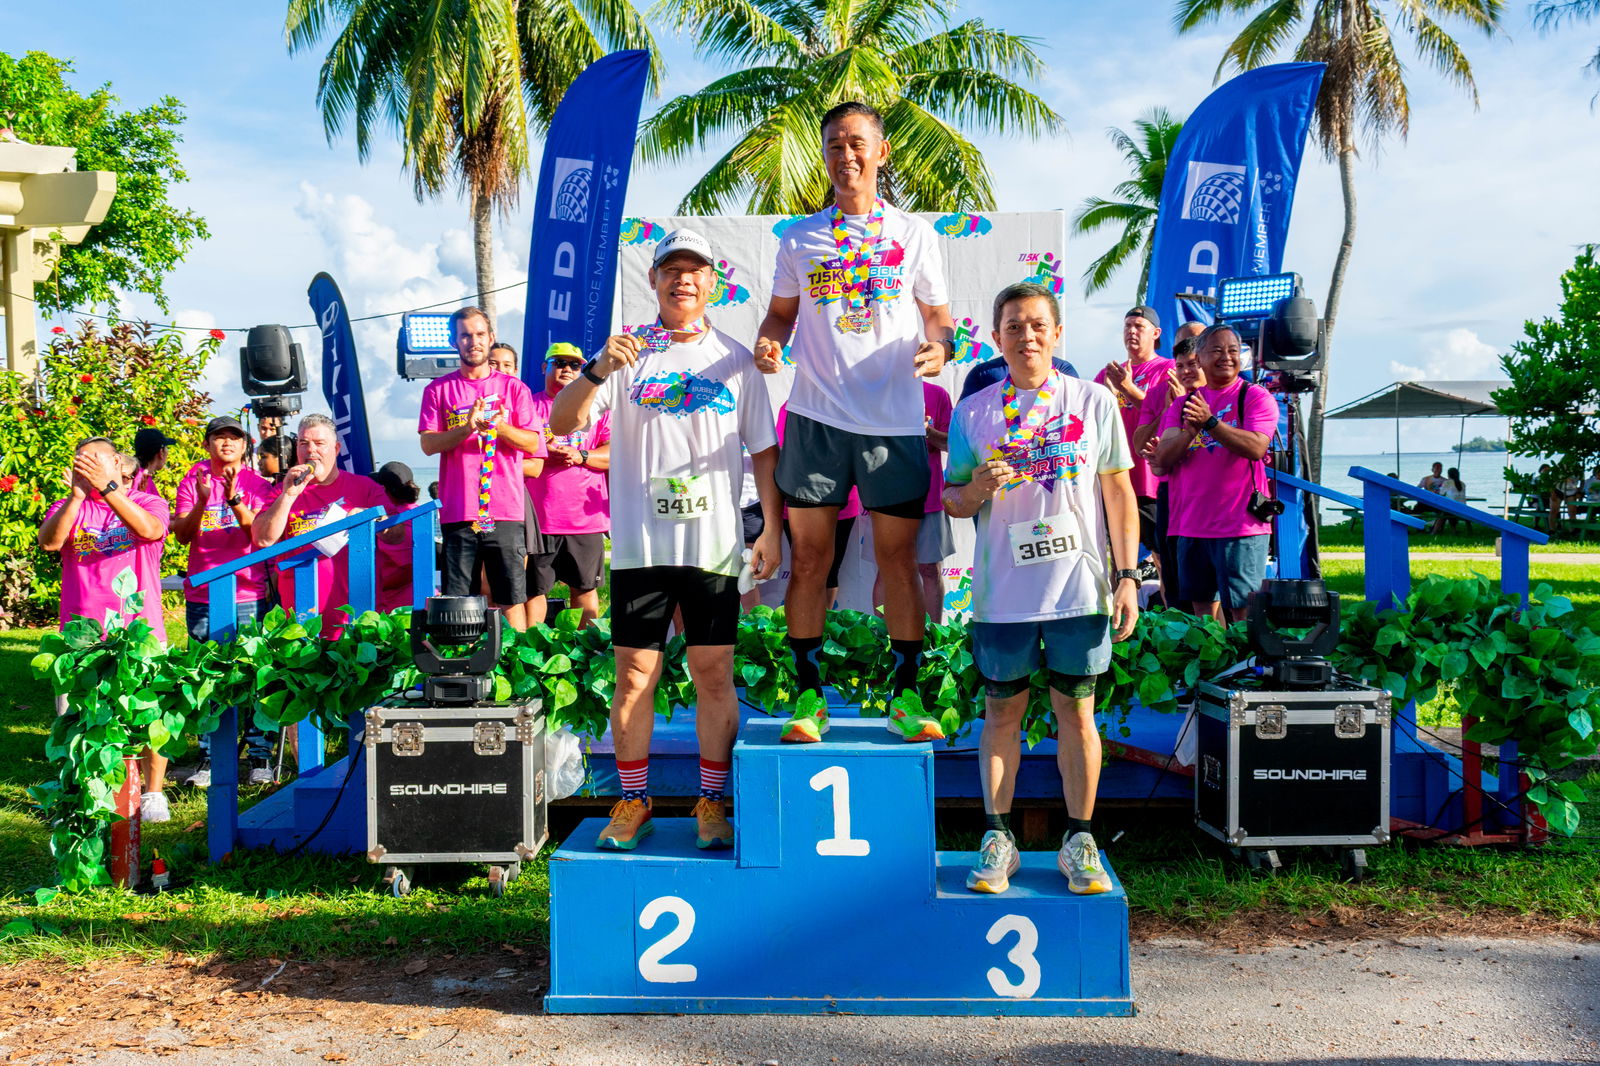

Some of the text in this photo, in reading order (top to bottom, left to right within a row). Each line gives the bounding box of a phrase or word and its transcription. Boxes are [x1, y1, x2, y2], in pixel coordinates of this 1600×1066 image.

[665, 236, 679, 247] DT
[1251, 202, 1273, 273] MEMBER
[588, 199, 611, 359] LLIANCE MEMBER
[808, 270, 844, 285] TJ5K
[692, 386, 718, 395] BUBBLE
[1030, 441, 1088, 461] BUBBLE
[1053, 454, 1087, 471] RUN
[1033, 473, 1058, 481] SAIPAN
[657, 496, 708, 514] 3414
[1019, 534, 1077, 560] 3691
[1253, 769, 1367, 780] SOUNDHIRE
[389, 783, 507, 796] SOUNDHIRE
[810, 766, 870, 857] 1
[638, 895, 698, 984] 2
[986, 914, 1041, 998] 3
